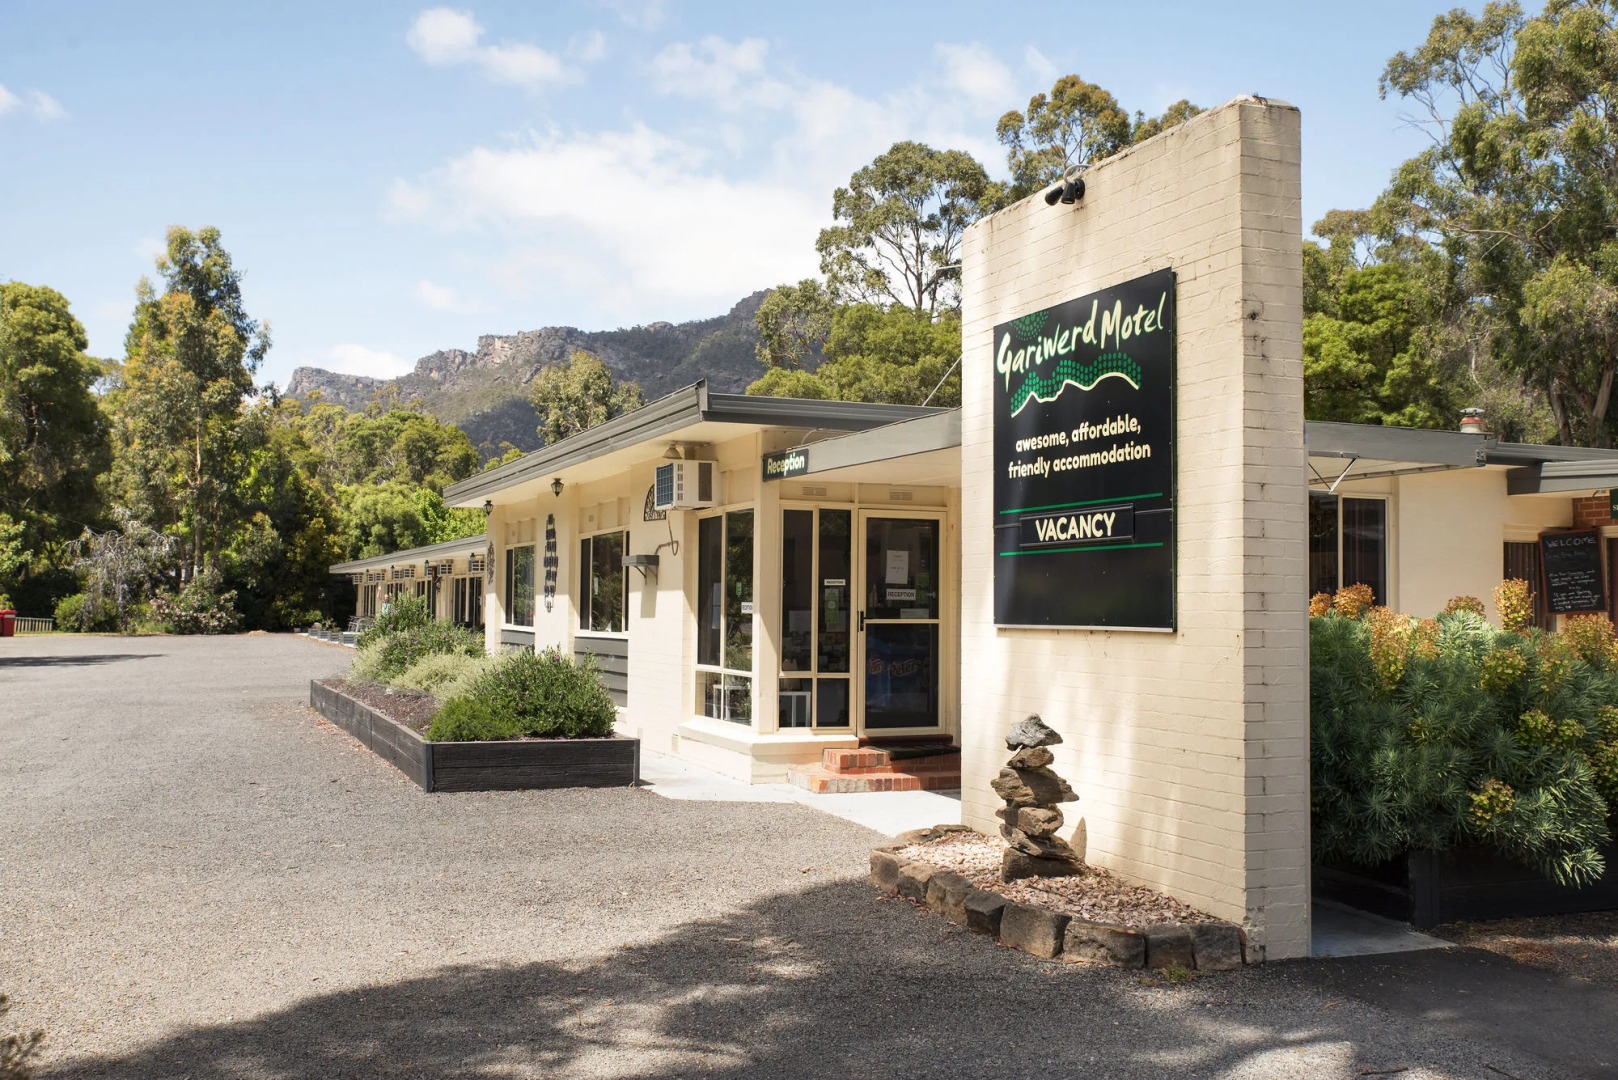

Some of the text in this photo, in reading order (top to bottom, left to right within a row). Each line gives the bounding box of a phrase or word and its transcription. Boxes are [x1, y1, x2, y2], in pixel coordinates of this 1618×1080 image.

[997, 291, 1166, 393] Gariwerd Motel
[1015, 413, 1141, 453] awesome, affordable,
[767, 452, 805, 477] Reception
[1008, 441, 1151, 479] friendly accommodation
[1035, 511, 1116, 542] VACANCY
[1545, 536, 1597, 548] WELCOME
